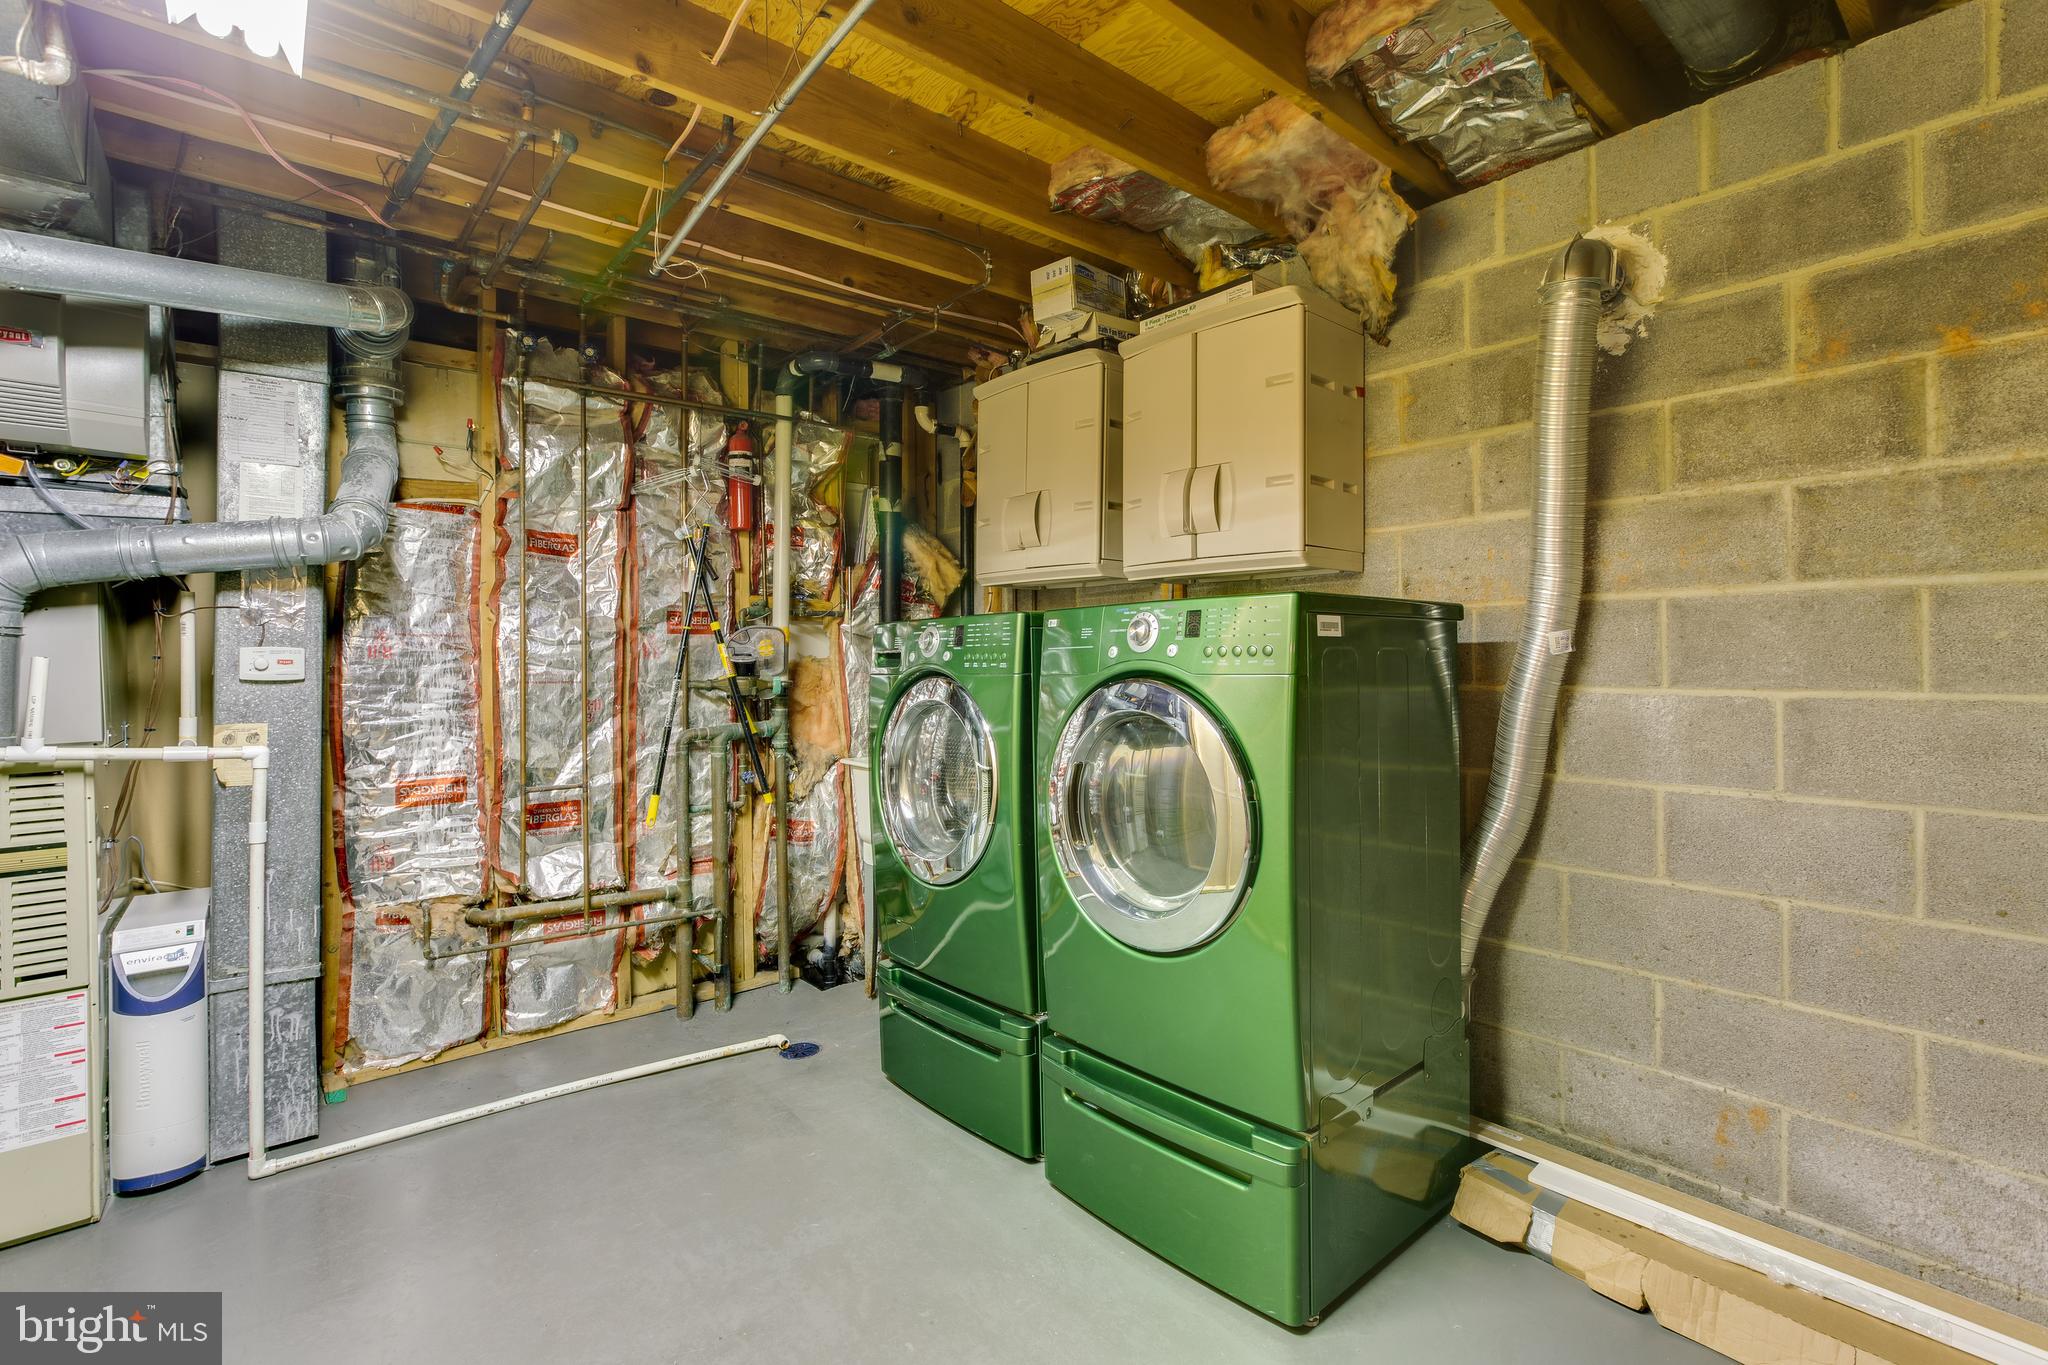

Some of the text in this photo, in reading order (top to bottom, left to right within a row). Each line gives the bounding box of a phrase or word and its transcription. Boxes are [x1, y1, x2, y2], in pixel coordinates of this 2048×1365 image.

[1178, 307, 1188, 315] Tray
[525, 811, 578, 825] FIBERGLAS
[546, 916, 603, 933] FIERGLAS
[136, 1040, 152, 1111] Honeywell
